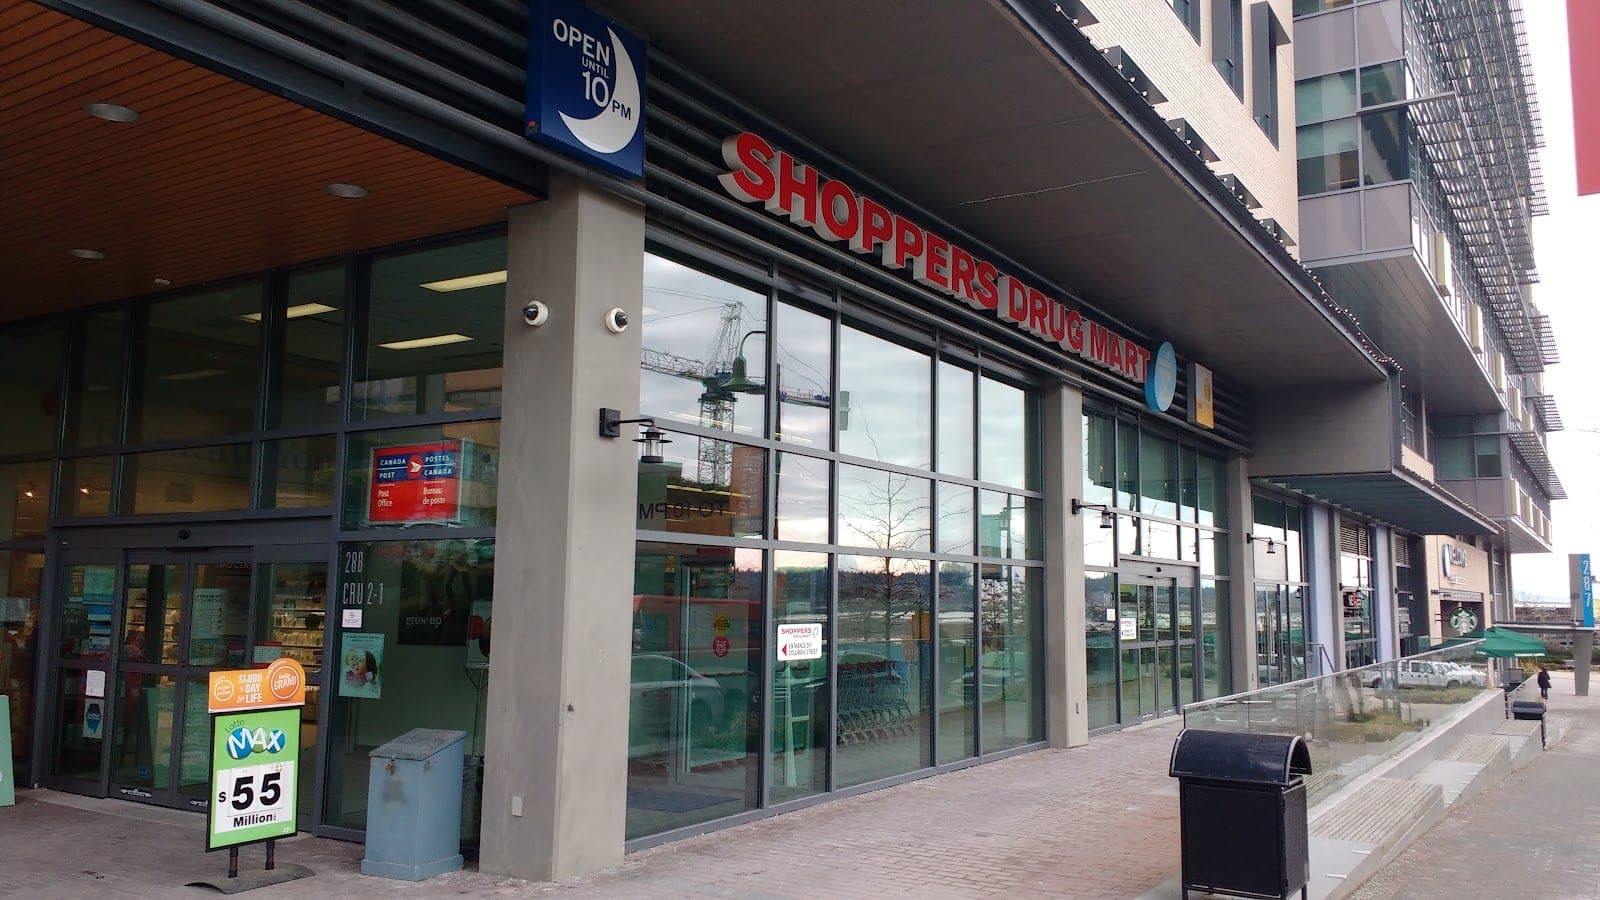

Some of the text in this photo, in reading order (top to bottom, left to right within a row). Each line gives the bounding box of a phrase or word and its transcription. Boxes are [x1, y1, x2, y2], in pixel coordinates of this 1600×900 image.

[553, 18, 610, 67] OPEN
[582, 58, 609, 79] UNTIL
[582, 71, 631, 120] 10 PM
[728, 131, 1150, 384] SHOPPERS DRUG MART
[380, 458, 406, 466] CANADA
[425, 455, 450, 463] POSTES
[424, 468, 452, 476] CANADA
[378, 490, 389, 498] Post
[423, 487, 443, 495] Bureau
[377, 499, 393, 507] Office
[345, 551, 364, 573] 288
[1582, 560, 1592, 607] 287
[343, 582, 384, 605] CRU 2-1
[405, 616, 428, 628] grow
[781, 627, 812, 635] SHOPPERS
[245, 683, 261, 693] DAY
[274, 675, 297, 690] GRAND
[245, 693, 262, 703] LIFE
[228, 727, 283, 759] MAX
[218, 772, 281, 811] $ 55
[233, 813, 273, 828] Million
